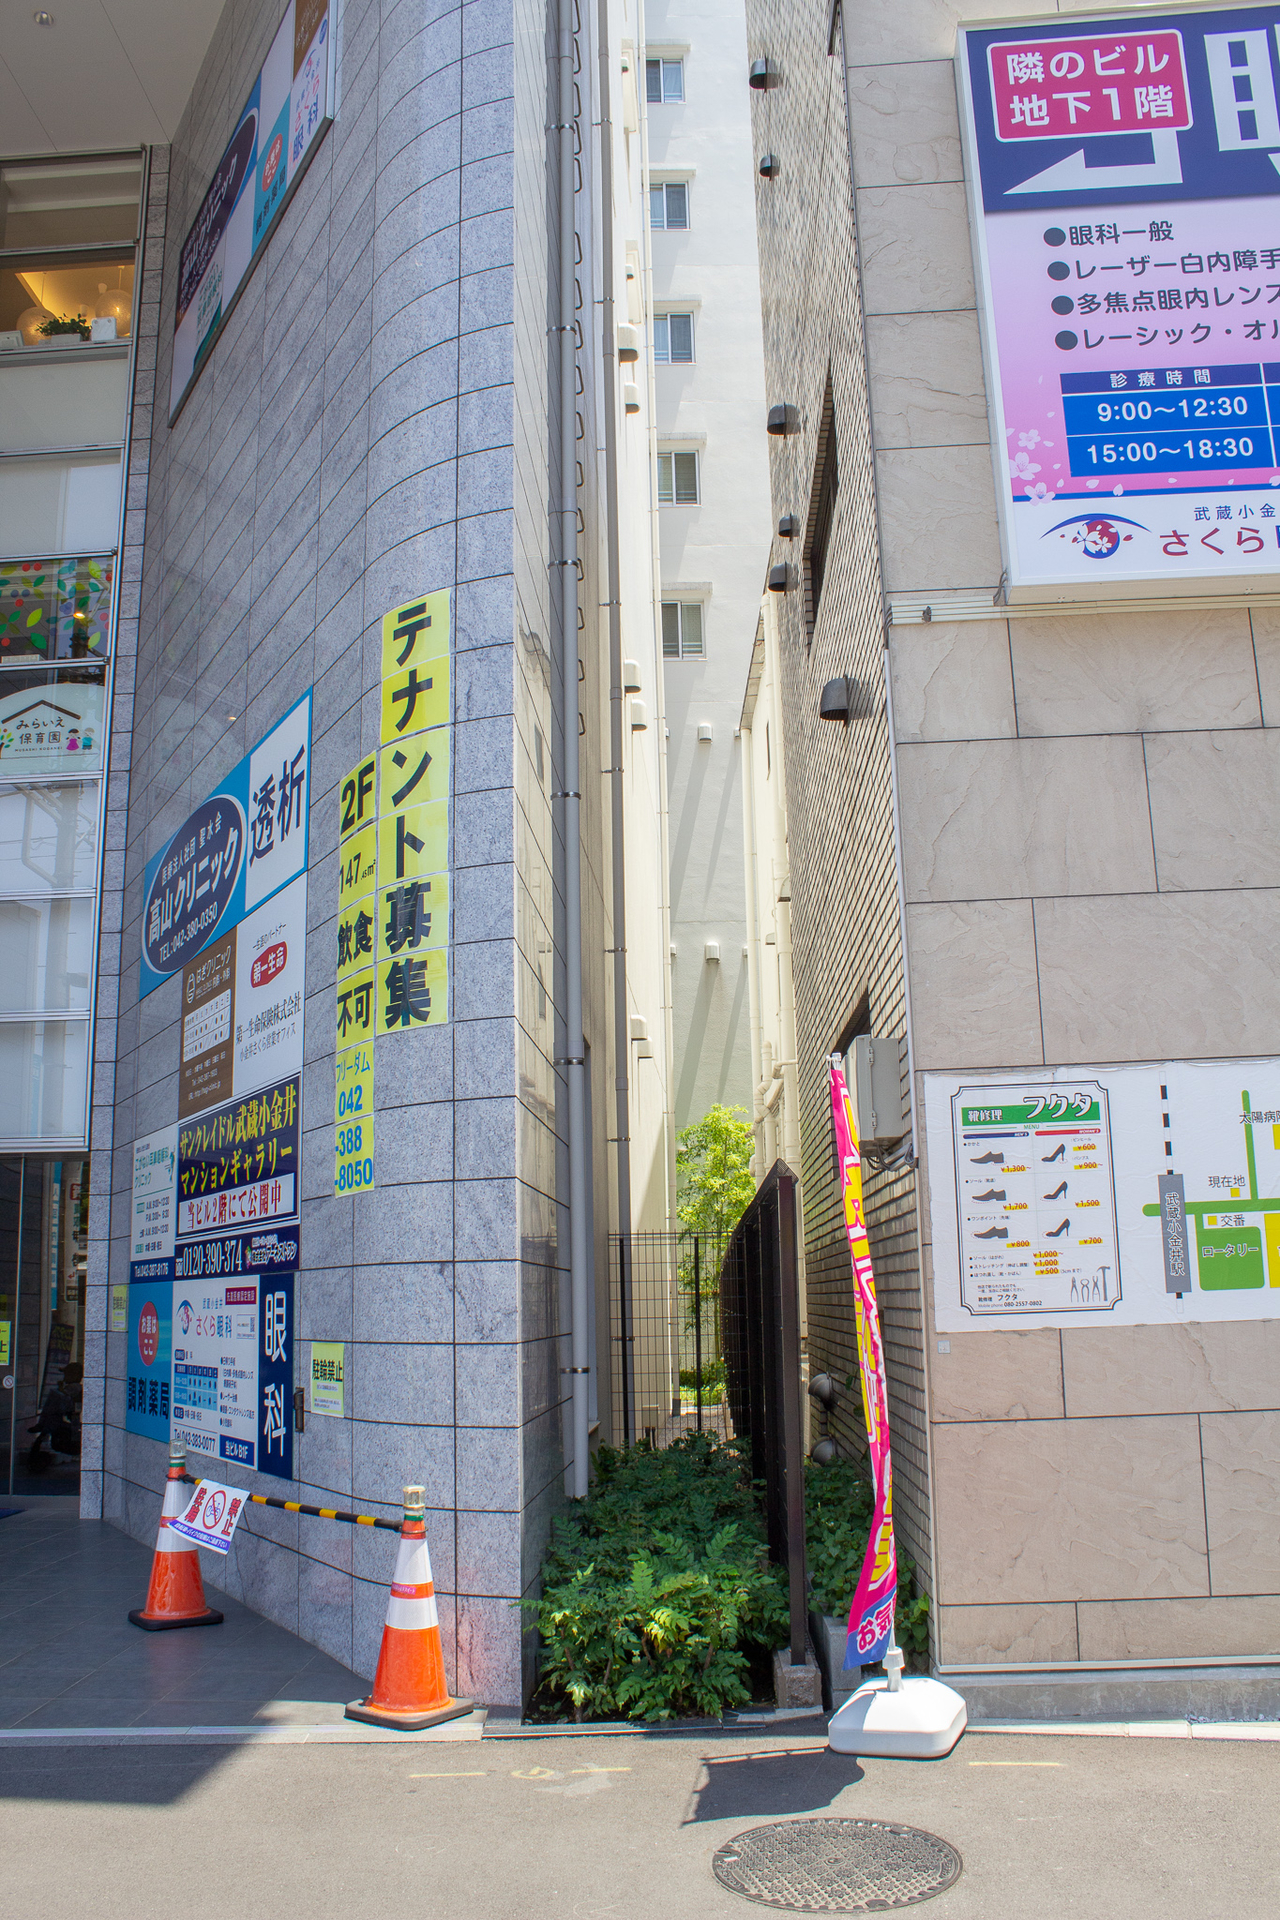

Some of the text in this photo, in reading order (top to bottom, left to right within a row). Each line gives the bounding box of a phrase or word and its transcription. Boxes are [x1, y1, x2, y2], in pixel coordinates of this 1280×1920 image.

[1006, 44, 1169, 86] 隣のビル
[1009, 85, 1174, 127] 地下1階
[1069, 221, 1174, 246] 眼科一般
[1110, 368, 1211, 389] 診療時間
[1097, 396, 1248, 422] 9:00〜12:30
[1087, 437, 1254, 464] 15:00〜18:30
[1194, 503, 1276, 521] 武蔵小金
[1159, 525, 1280, 557] さくら
[16, 716, 65, 730] みらいえ
[19, 731, 61, 745] 保育園
[249, 744, 306, 868] 透析
[340, 760, 375, 836] 2F
[385, 602, 433, 1029] テナント募集
[149, 827, 239, 948] 高山クリニック
[159, 902, 218, 964] TEL:042-380-0350
[337, 911, 373, 970] 飲食
[253, 945, 285, 984] 第一生命
[236, 990, 302, 1045] 第一生命保険株式会社
[337, 981, 374, 1038] 不可
[336, 1051, 371, 1083] フリーダム
[338, 1084, 363, 1117] 042
[968, 1092, 1093, 1122] 靴修理 フクタ
[180, 1084, 297, 1162] サンクレイドル武蔵小金井
[335, 1125, 362, 1157] -388
[181, 1137, 292, 1195] マンションギャラリー
[334, 1157, 373, 1191] -8050
[1208, 1175, 1246, 1188] 現在地
[187, 1179, 282, 1230] 当ビル2階にて公開中
[1003, 1202, 1028, 1210] ¥1,700
[1220, 1214, 1245, 1227] 交番
[1165, 1191, 1186, 1277] 武蔵小金井駅
[1202, 1243, 1260, 1258] ロータリー
[182, 1239, 243, 1276] 0120-390-374
[1034, 1259, 1058, 1267] ¥1,000
[1040, 1267, 1059, 1275] ¥500
[997, 1293, 1018, 1301] フクタ
[196, 1314, 233, 1339] さくら眼科
[264, 1291, 287, 1457] 眼科
[312, 1359, 344, 1383] 駐輪禁止
[128, 1376, 169, 1420] 調剤薬局
[221, 1497, 241, 1537] 禁止
[857, 1596, 897, 1654] お気
